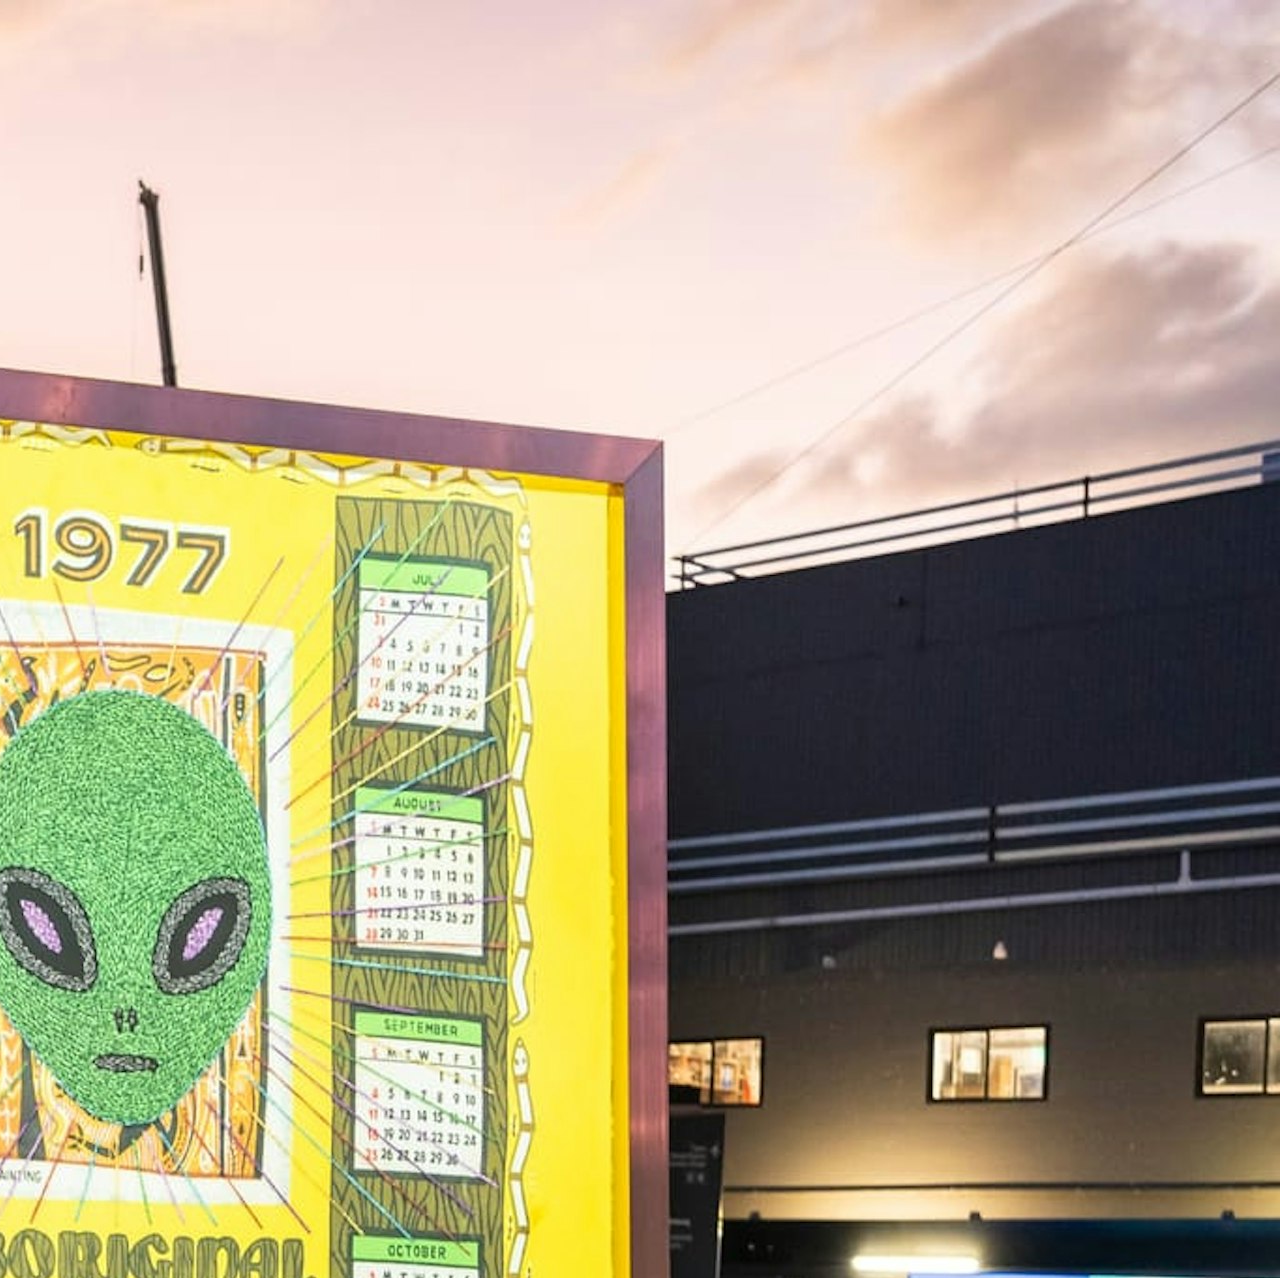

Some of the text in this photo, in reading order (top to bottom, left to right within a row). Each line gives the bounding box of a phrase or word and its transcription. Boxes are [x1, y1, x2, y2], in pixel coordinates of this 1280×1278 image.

[14, 514, 226, 596] 1977
[395, 798, 441, 811] AUGUST
[384, 1019, 458, 1036] SEPTEMBER
[388, 1245, 446, 1259] OCTOBER
